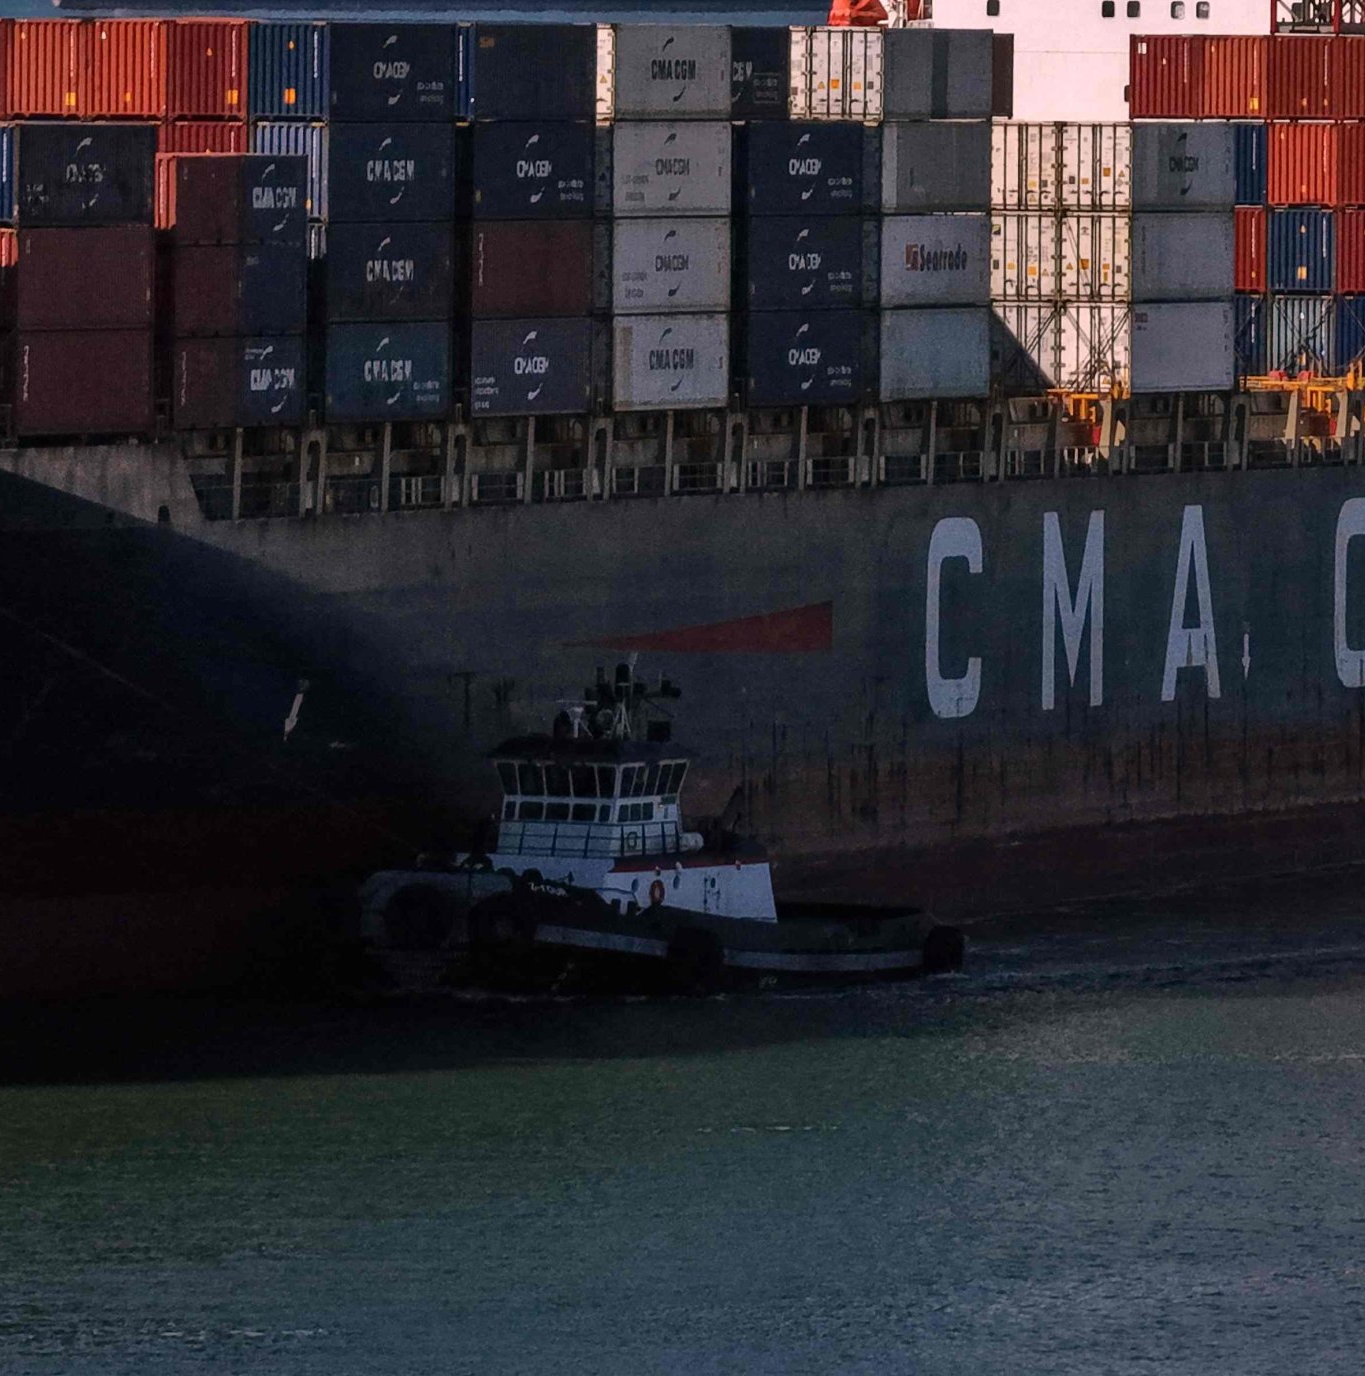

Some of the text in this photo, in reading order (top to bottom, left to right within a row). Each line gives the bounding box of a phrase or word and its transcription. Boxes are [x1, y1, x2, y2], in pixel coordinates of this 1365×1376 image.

[651, 59, 696, 81] CMA CGM
[919, 244, 967, 272] Seatrade
[649, 349, 694, 370] CMA CGM
[925, 504, 1221, 719] CMA
